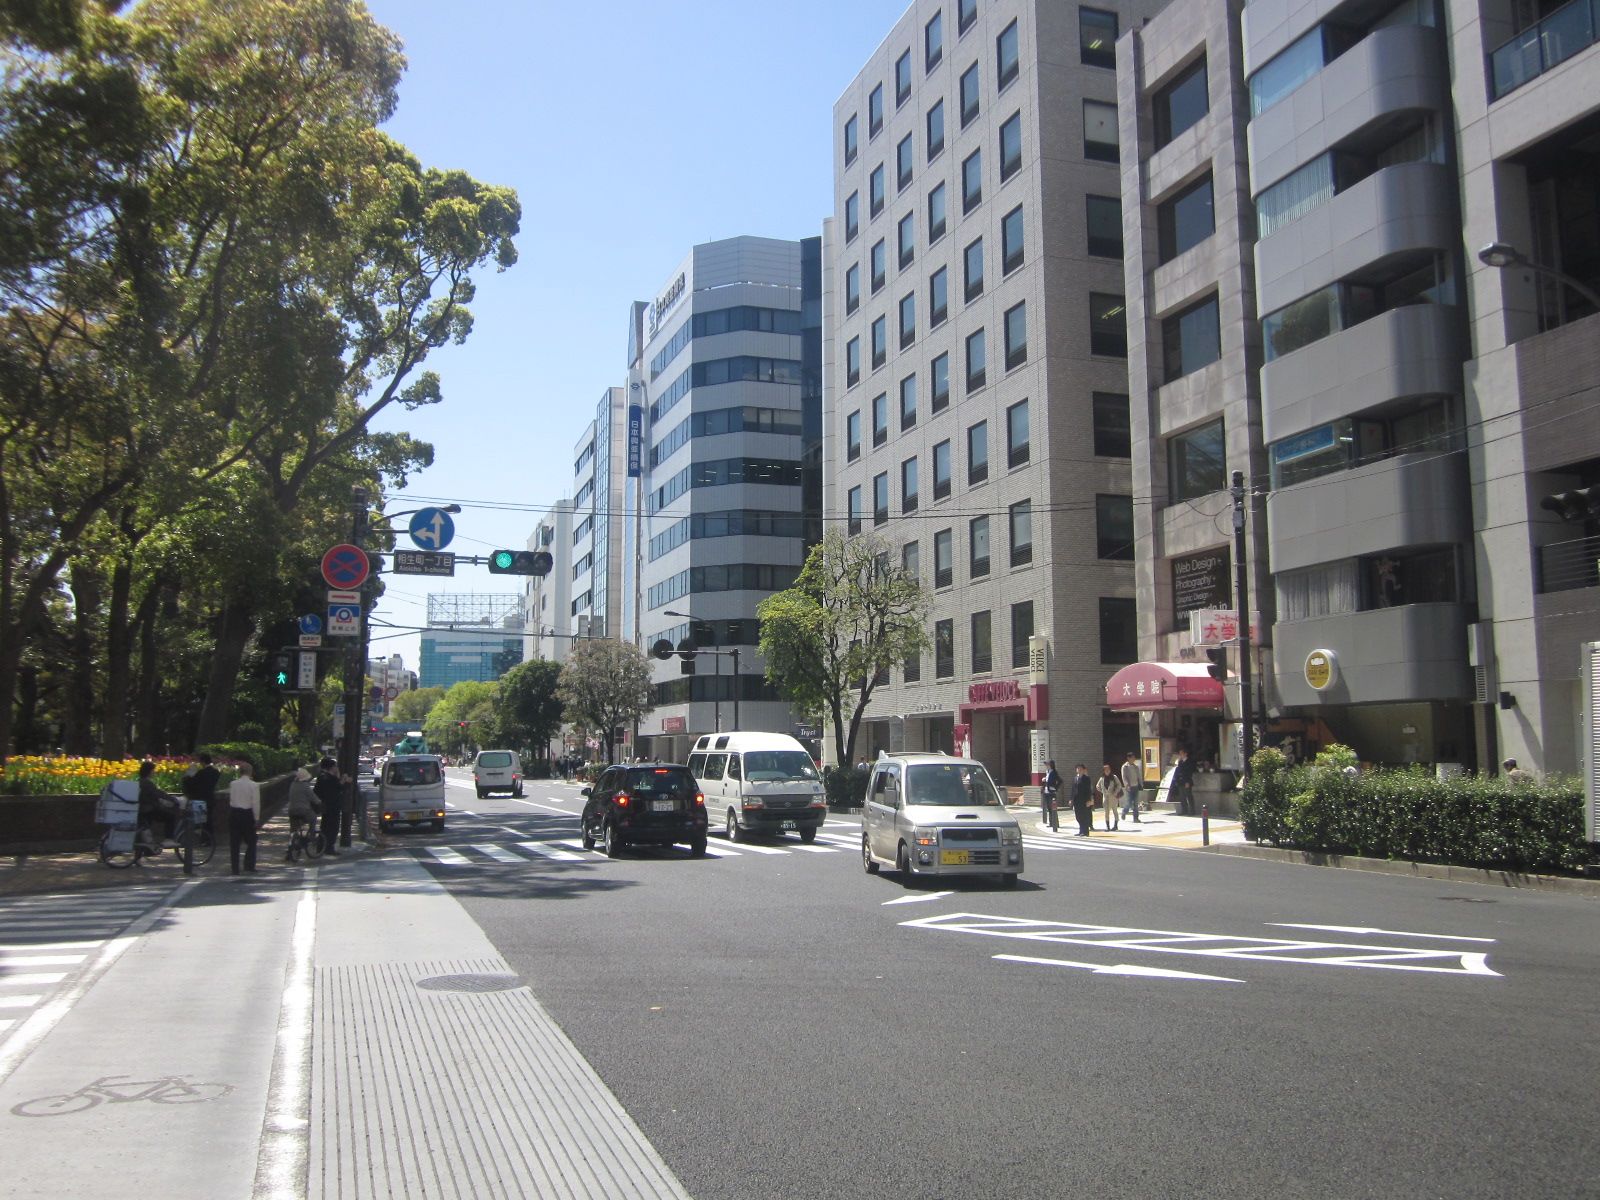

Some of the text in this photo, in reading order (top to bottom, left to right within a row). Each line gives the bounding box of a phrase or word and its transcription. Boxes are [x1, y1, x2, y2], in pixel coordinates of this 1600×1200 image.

[398, 553, 452, 567] 相生町一丁目
[1175, 561, 1190, 574] Web
[1191, 557, 1216, 571] Design
[1175, 576, 1211, 590] Photography
[1122, 680, 1160, 696] 大学院
